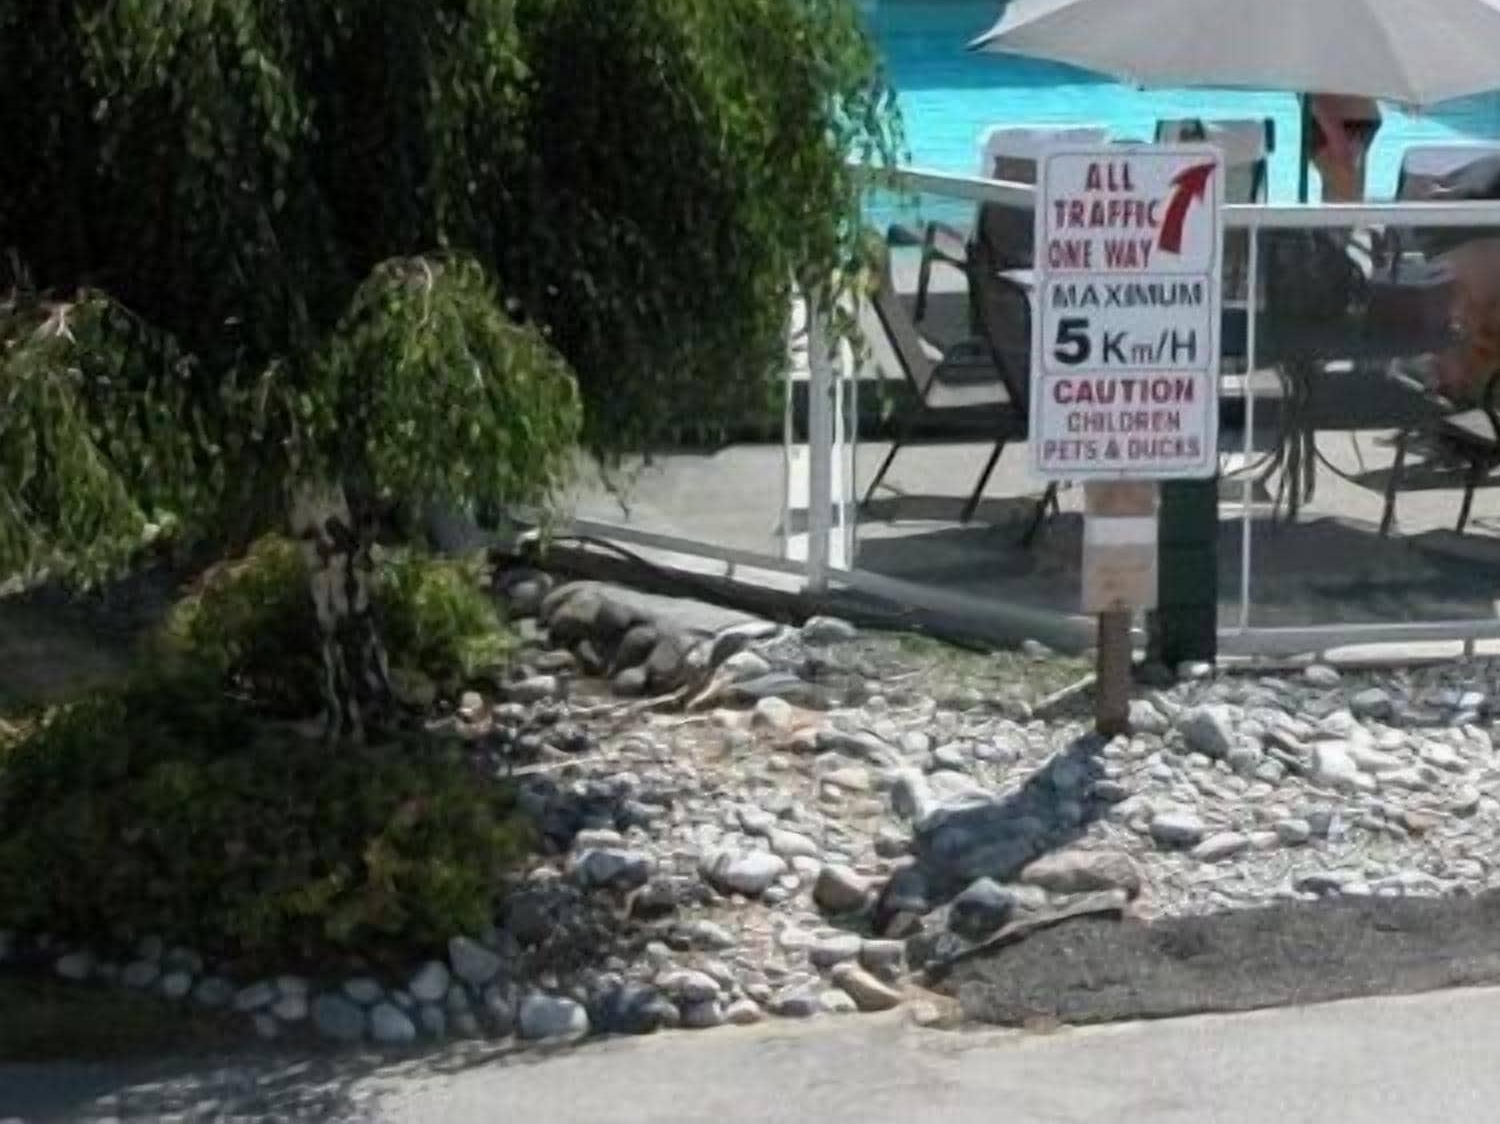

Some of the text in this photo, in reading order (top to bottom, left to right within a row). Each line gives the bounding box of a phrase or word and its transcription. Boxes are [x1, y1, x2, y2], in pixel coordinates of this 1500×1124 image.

[1086, 163, 1133, 191] ALL
[1054, 199, 1160, 229] TRAFFIC
[1048, 238, 1152, 268] ONE WAY
[1052, 284, 1201, 308] MAXIMUM
[1054, 317, 1090, 364] 5
[1053, 378, 1193, 405] CAUTION
[1066, 411, 1180, 433] CHILDREN
[1043, 438, 1200, 462] PETS & DUCKS
